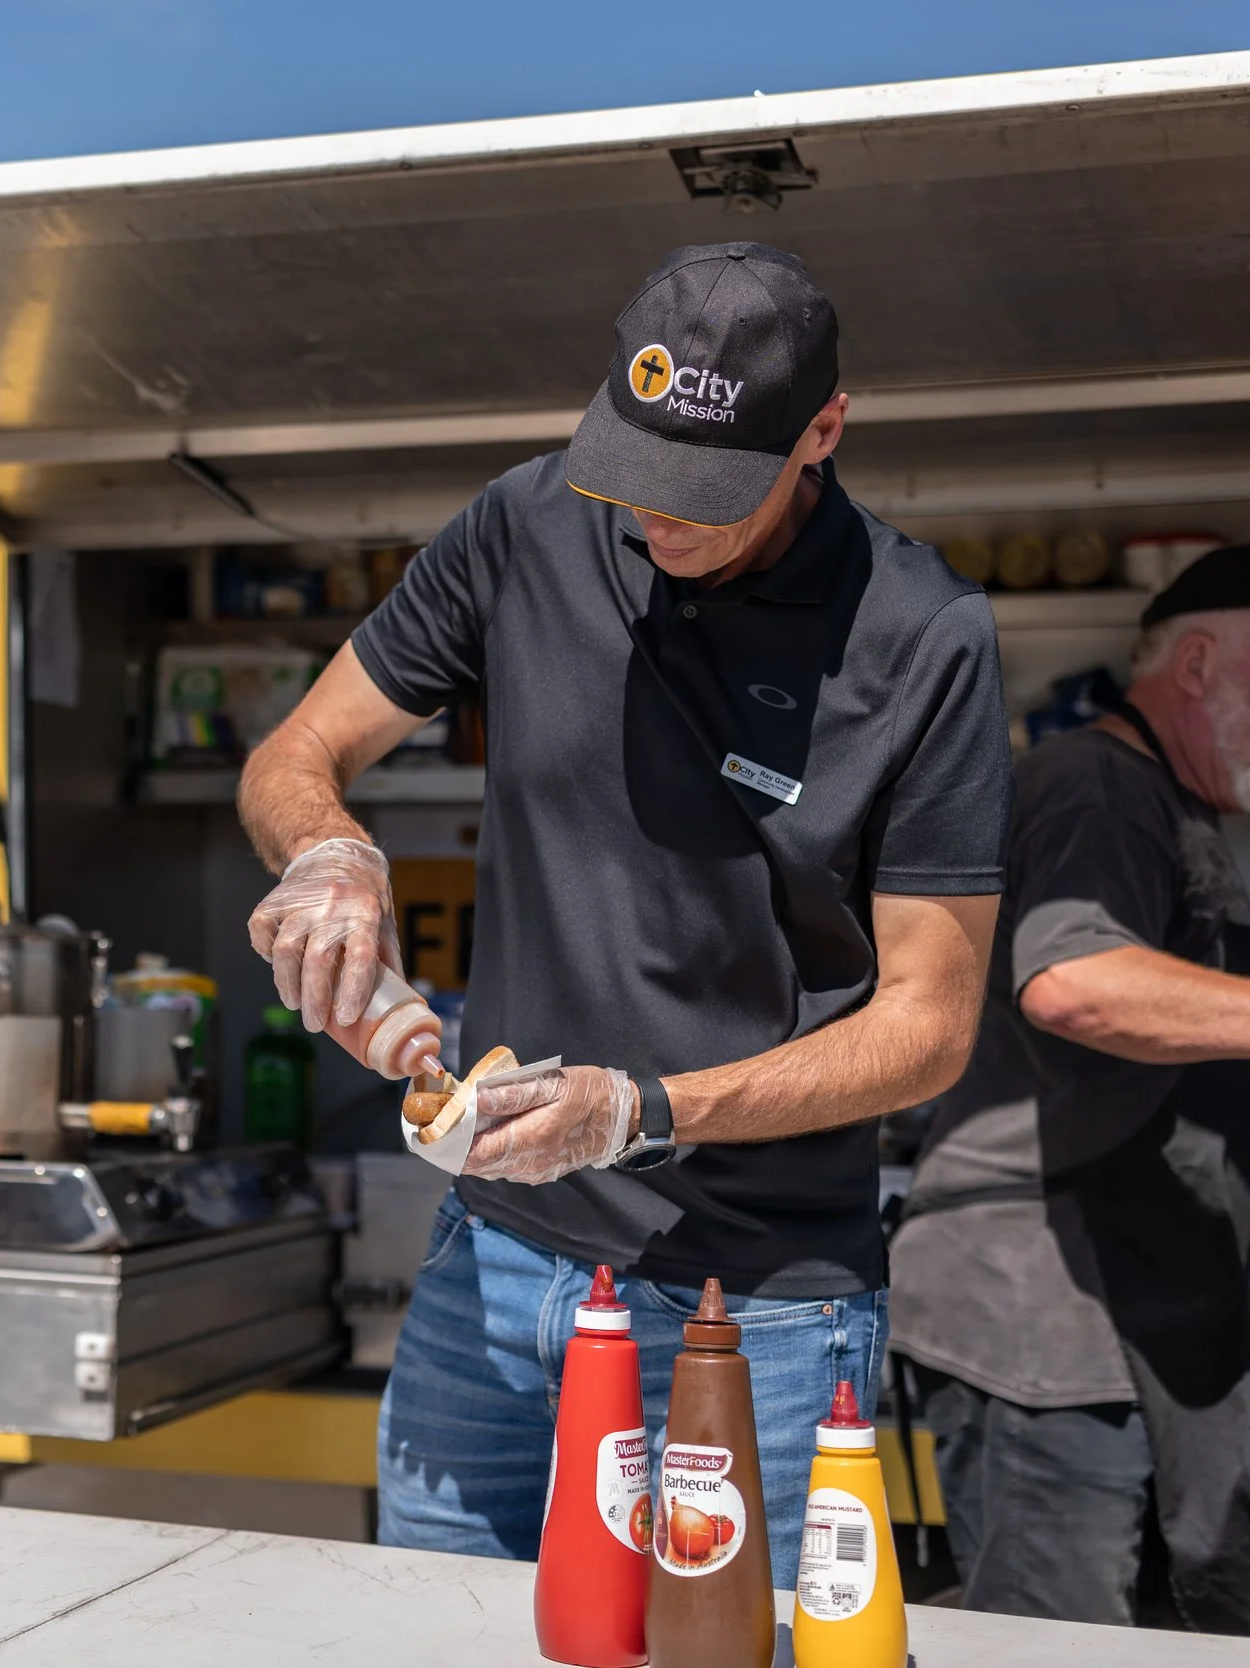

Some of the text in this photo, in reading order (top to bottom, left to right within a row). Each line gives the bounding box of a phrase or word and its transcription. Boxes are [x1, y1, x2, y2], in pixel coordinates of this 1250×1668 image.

[673, 366, 744, 407] City
[666, 395, 735, 423] Mission
[740, 766, 756, 778] City
[759, 770, 773, 781] Ray
[774, 777, 796, 791] Green
[619, 1461, 649, 1478] TOMA
[666, 1454, 720, 1469] MasterFoods
[664, 1473, 722, 1493] Barbecue
[679, 1490, 695, 1499] SAUCE
